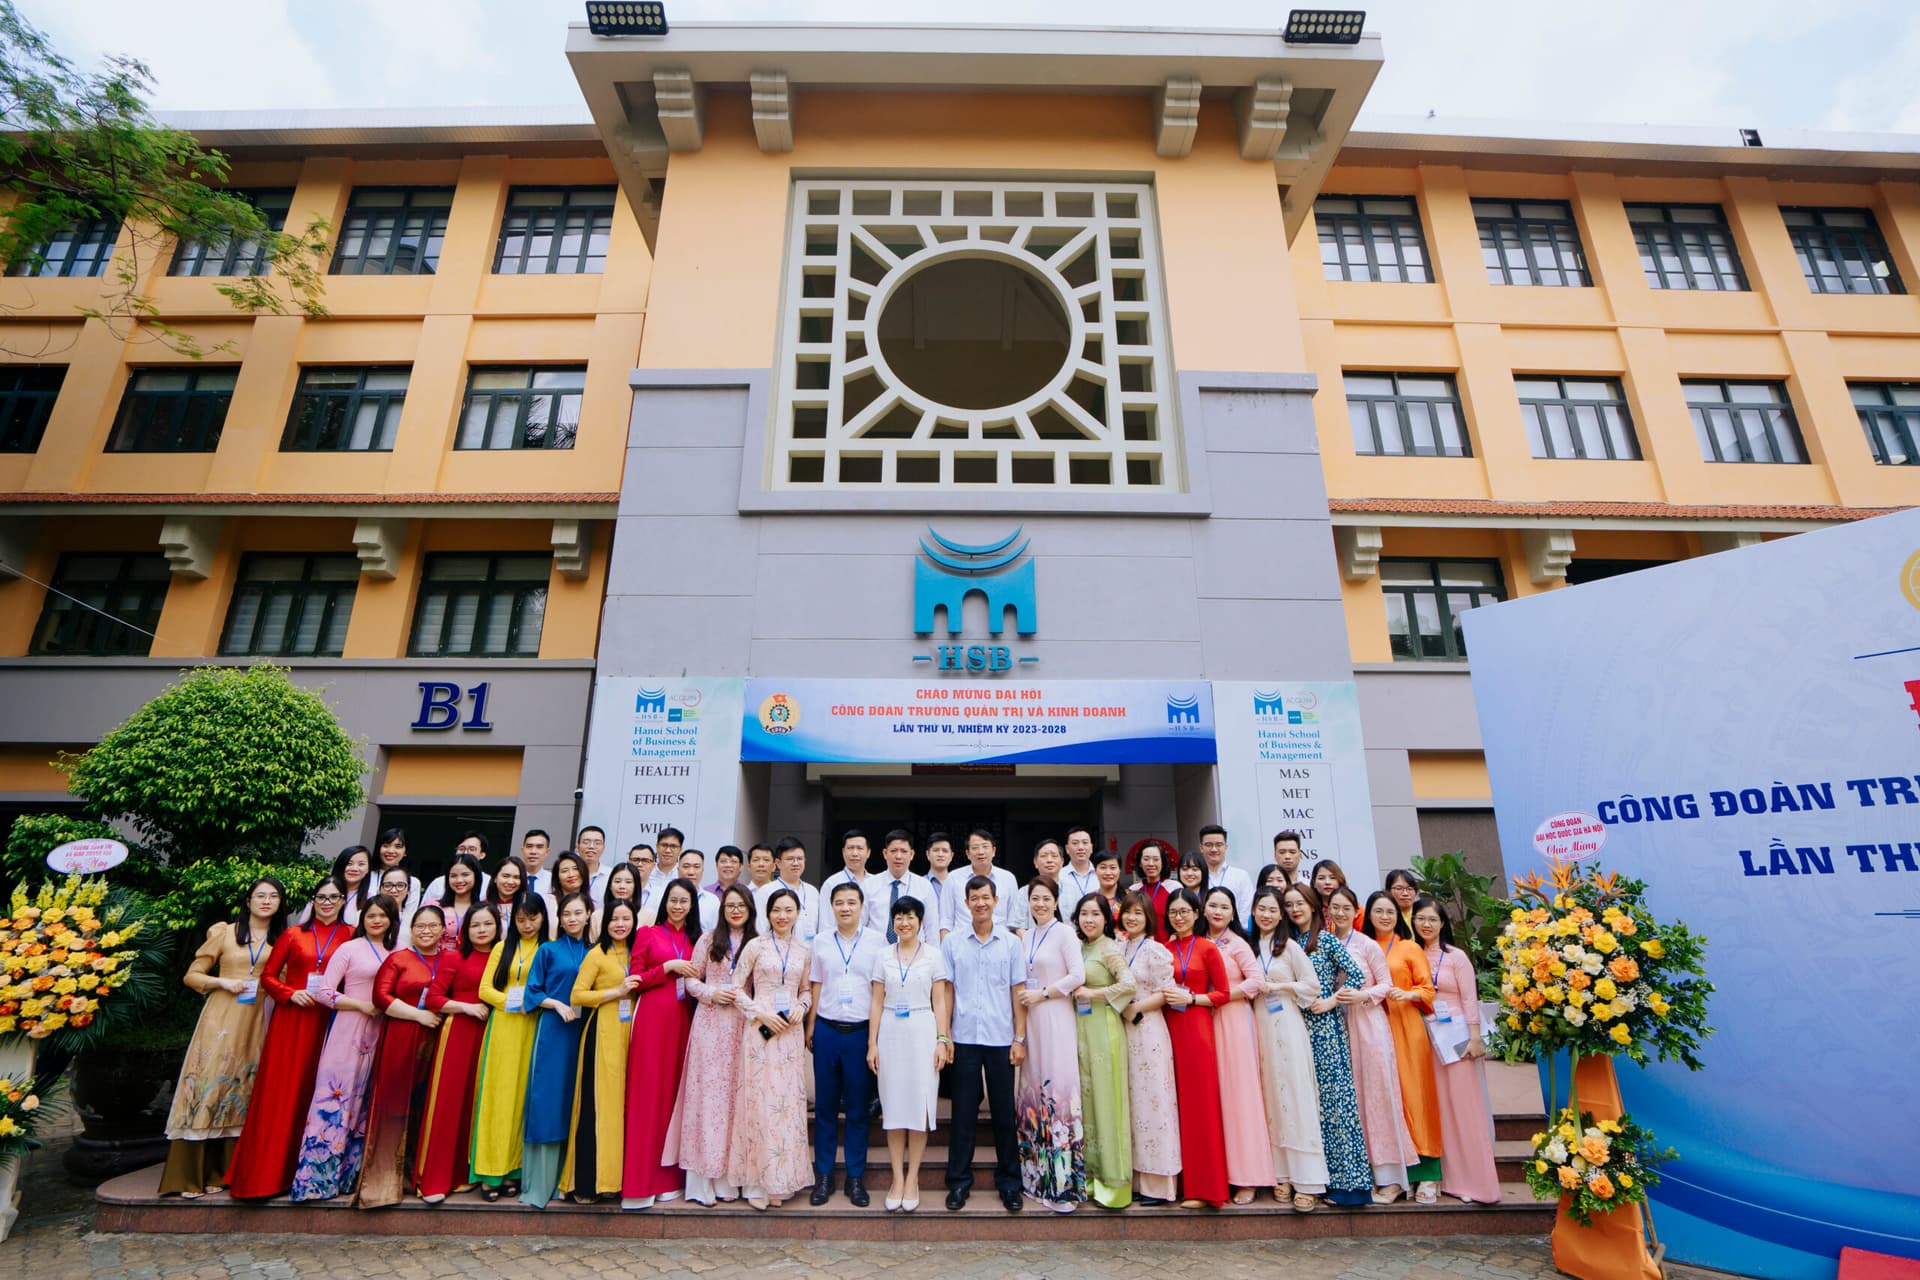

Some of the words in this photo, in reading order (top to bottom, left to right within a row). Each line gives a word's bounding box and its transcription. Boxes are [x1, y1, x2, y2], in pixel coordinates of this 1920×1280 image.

[937, 645, 1013, 671] HSB
[410, 681, 493, 730] B1
[1002, 706, 1023, 718] TRỊ
[1048, 706, 1079, 717] KINH
[1083, 706, 1126, 717] DOANH
[634, 726, 663, 735] Hanoi
[666, 726, 698, 735] School
[941, 724, 955, 735] VI,
[1012, 724, 1067, 734] 2023-2028
[1258, 730, 1286, 738] Hanoi
[1289, 730, 1320, 739] School
[632, 738, 642, 746] of
[645, 737, 686, 746] Business
[688, 738, 697, 746] &
[1259, 741, 1268, 749] of
[1271, 740, 1312, 749] Business
[1314, 741, 1323, 749] &
[632, 748, 696, 758] Management
[1260, 751, 1323, 761] Management
[634, 766, 690, 776] HEALTH
[1280, 769, 1310, 779] MAS
[1282, 788, 1311, 799] MET
[634, 794, 685, 805] ETHICS
[1597, 794, 1700, 825] CÔNG
[1709, 781, 1836, 817] ĐOÀN
[1846, 775, 1920, 807] TR
[1282, 808, 1315, 819] MAC
[1739, 838, 1835, 876] LẦN
[1846, 842, 1920, 873] TH
